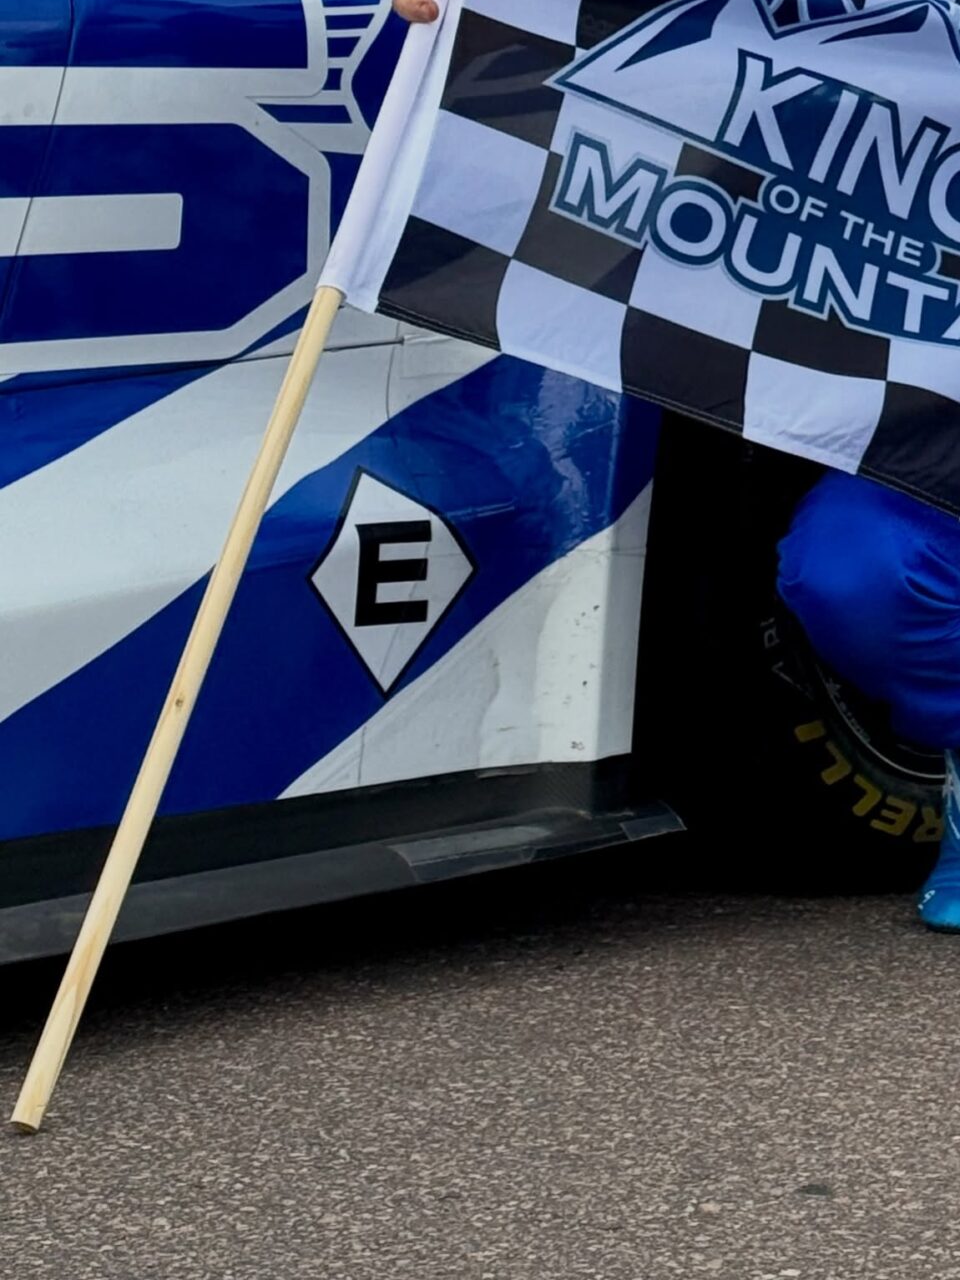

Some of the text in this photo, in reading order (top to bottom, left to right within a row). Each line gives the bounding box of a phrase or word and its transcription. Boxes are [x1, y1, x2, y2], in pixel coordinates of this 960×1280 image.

[768, 183, 925, 267] OF THE
[354, 520, 433, 627] E
